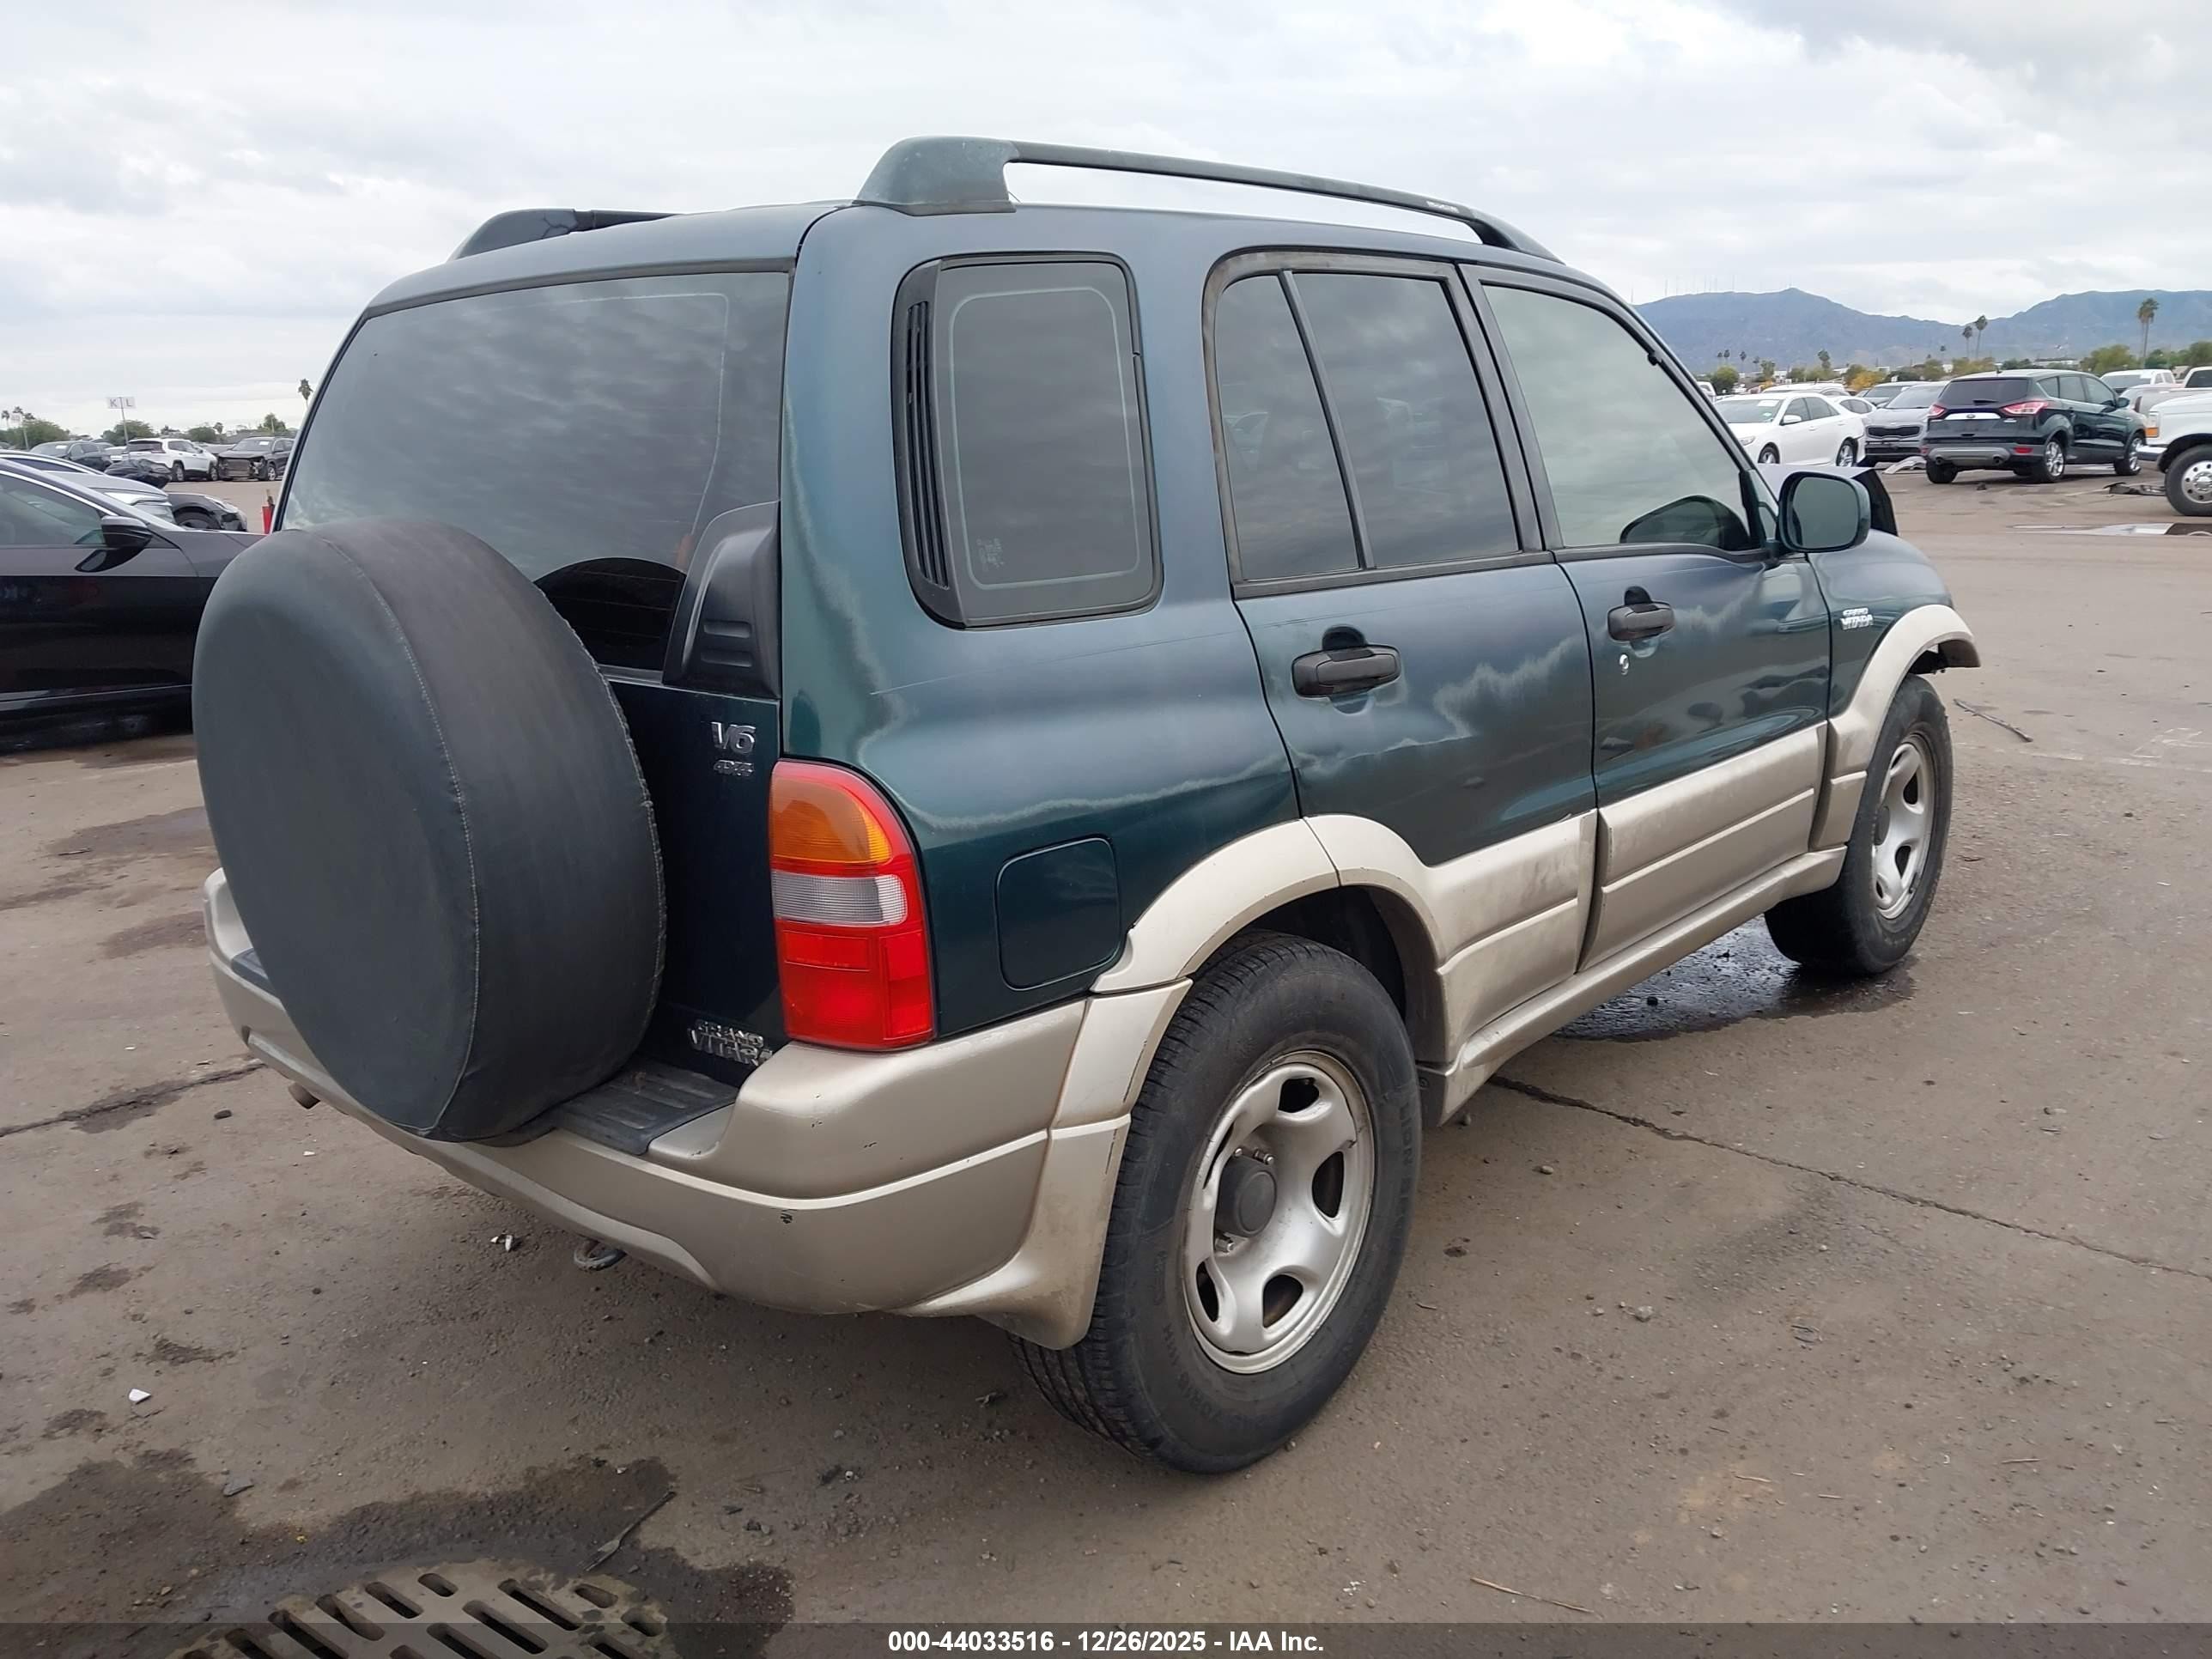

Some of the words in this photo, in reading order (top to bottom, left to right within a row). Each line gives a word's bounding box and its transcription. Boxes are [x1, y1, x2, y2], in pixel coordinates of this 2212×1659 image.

[109, 398, 118, 407] K
[125, 398, 134, 407] L
[710, 721, 756, 753] V6
